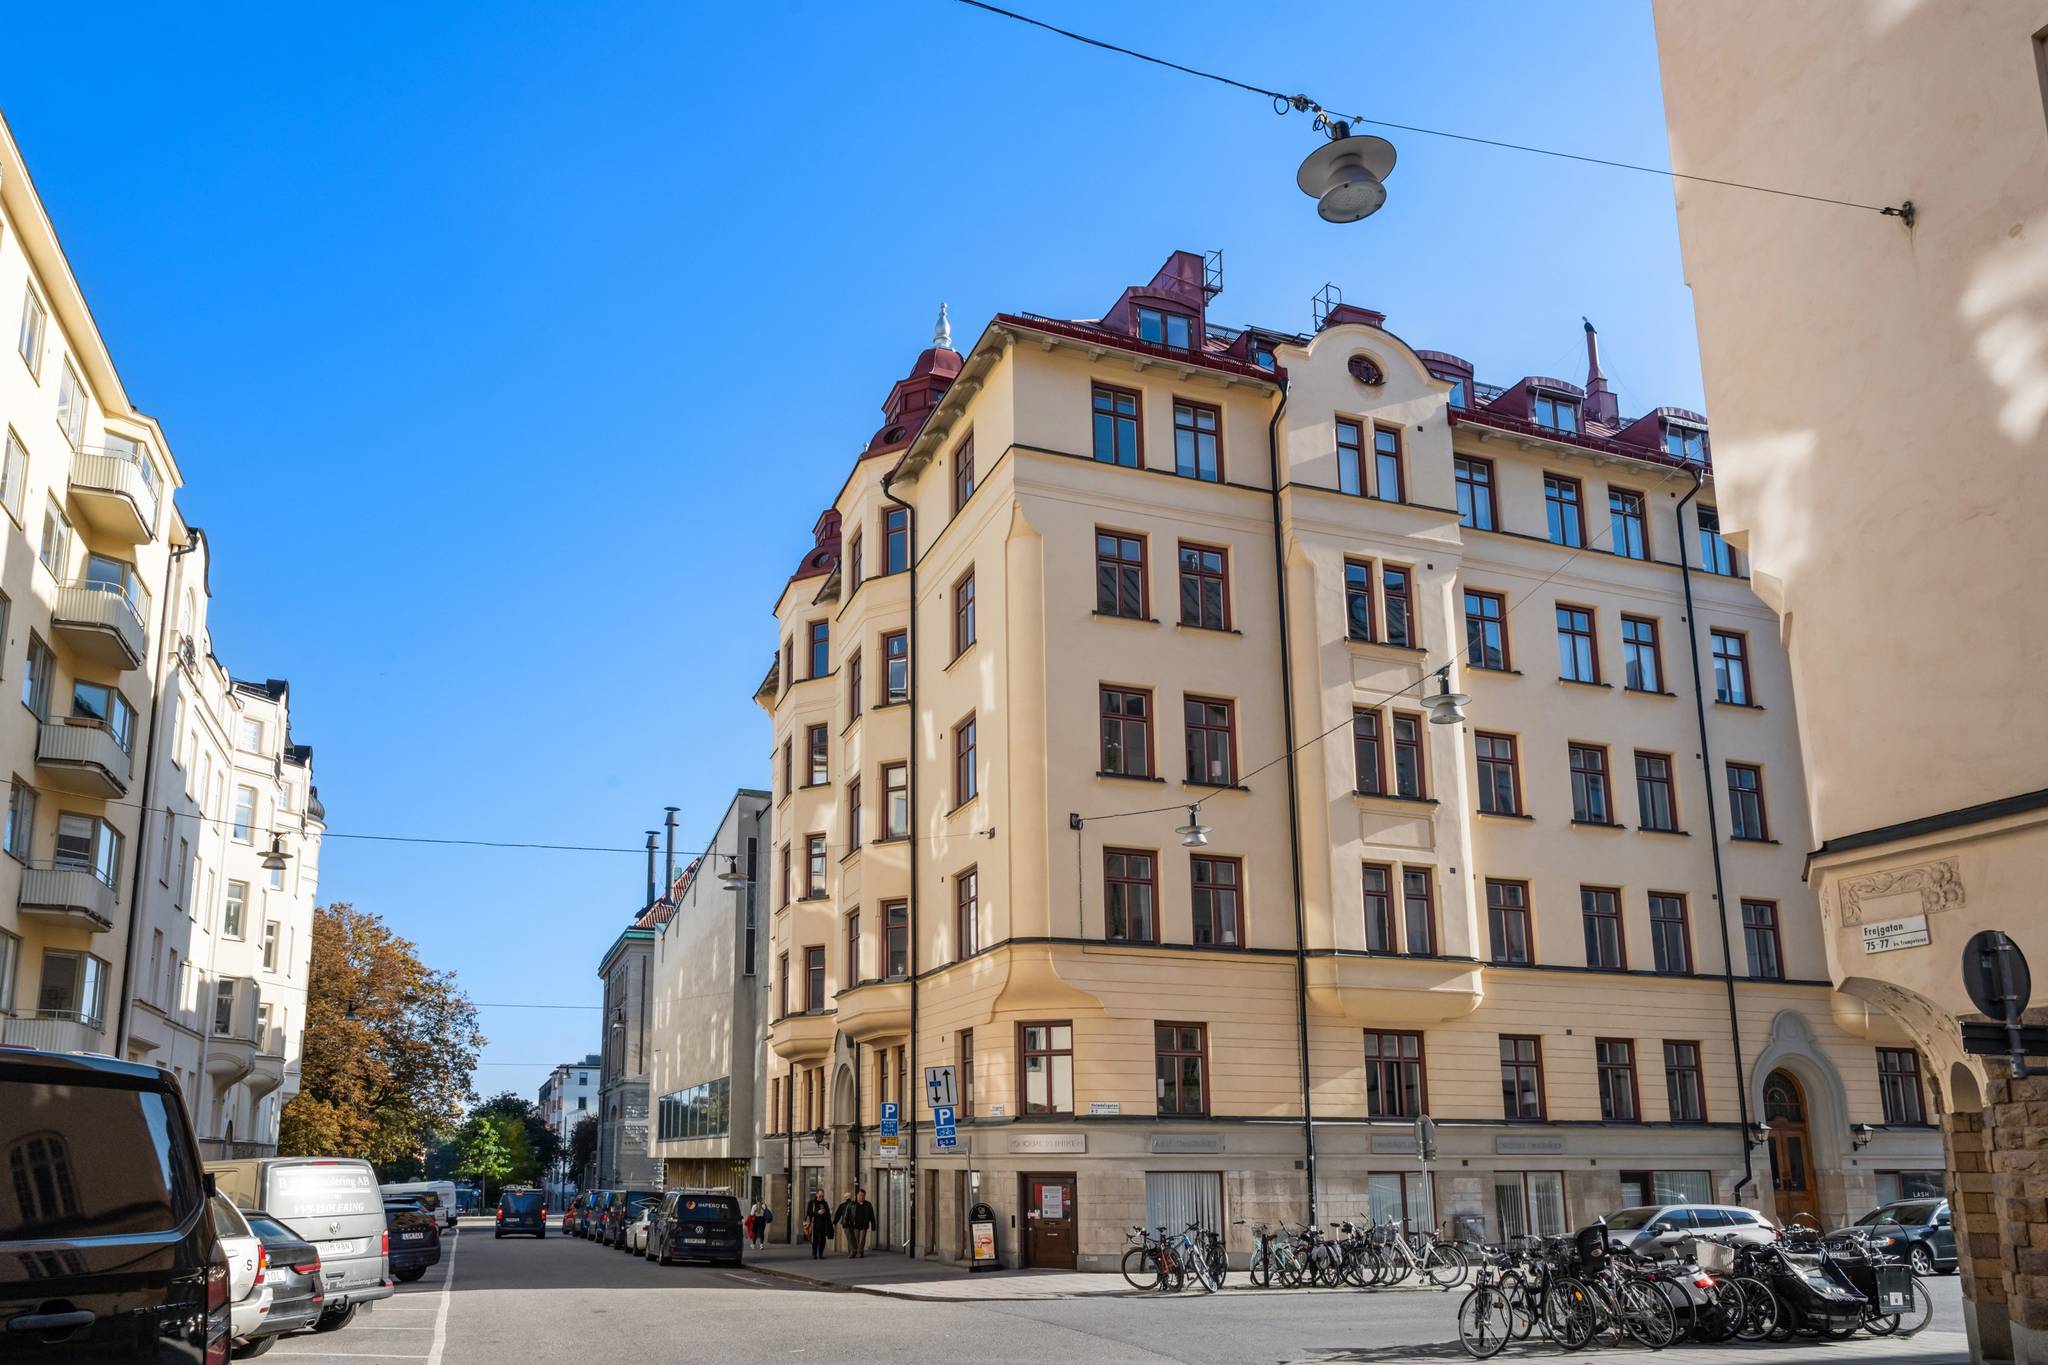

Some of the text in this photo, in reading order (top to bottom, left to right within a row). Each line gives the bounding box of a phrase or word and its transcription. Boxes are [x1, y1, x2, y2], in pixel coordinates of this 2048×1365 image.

[1864, 924, 1903, 936] Frejgatan
[885, 1104, 895, 1118] P
[939, 1108, 951, 1125] P
[246, 1259, 253, 1271] S
